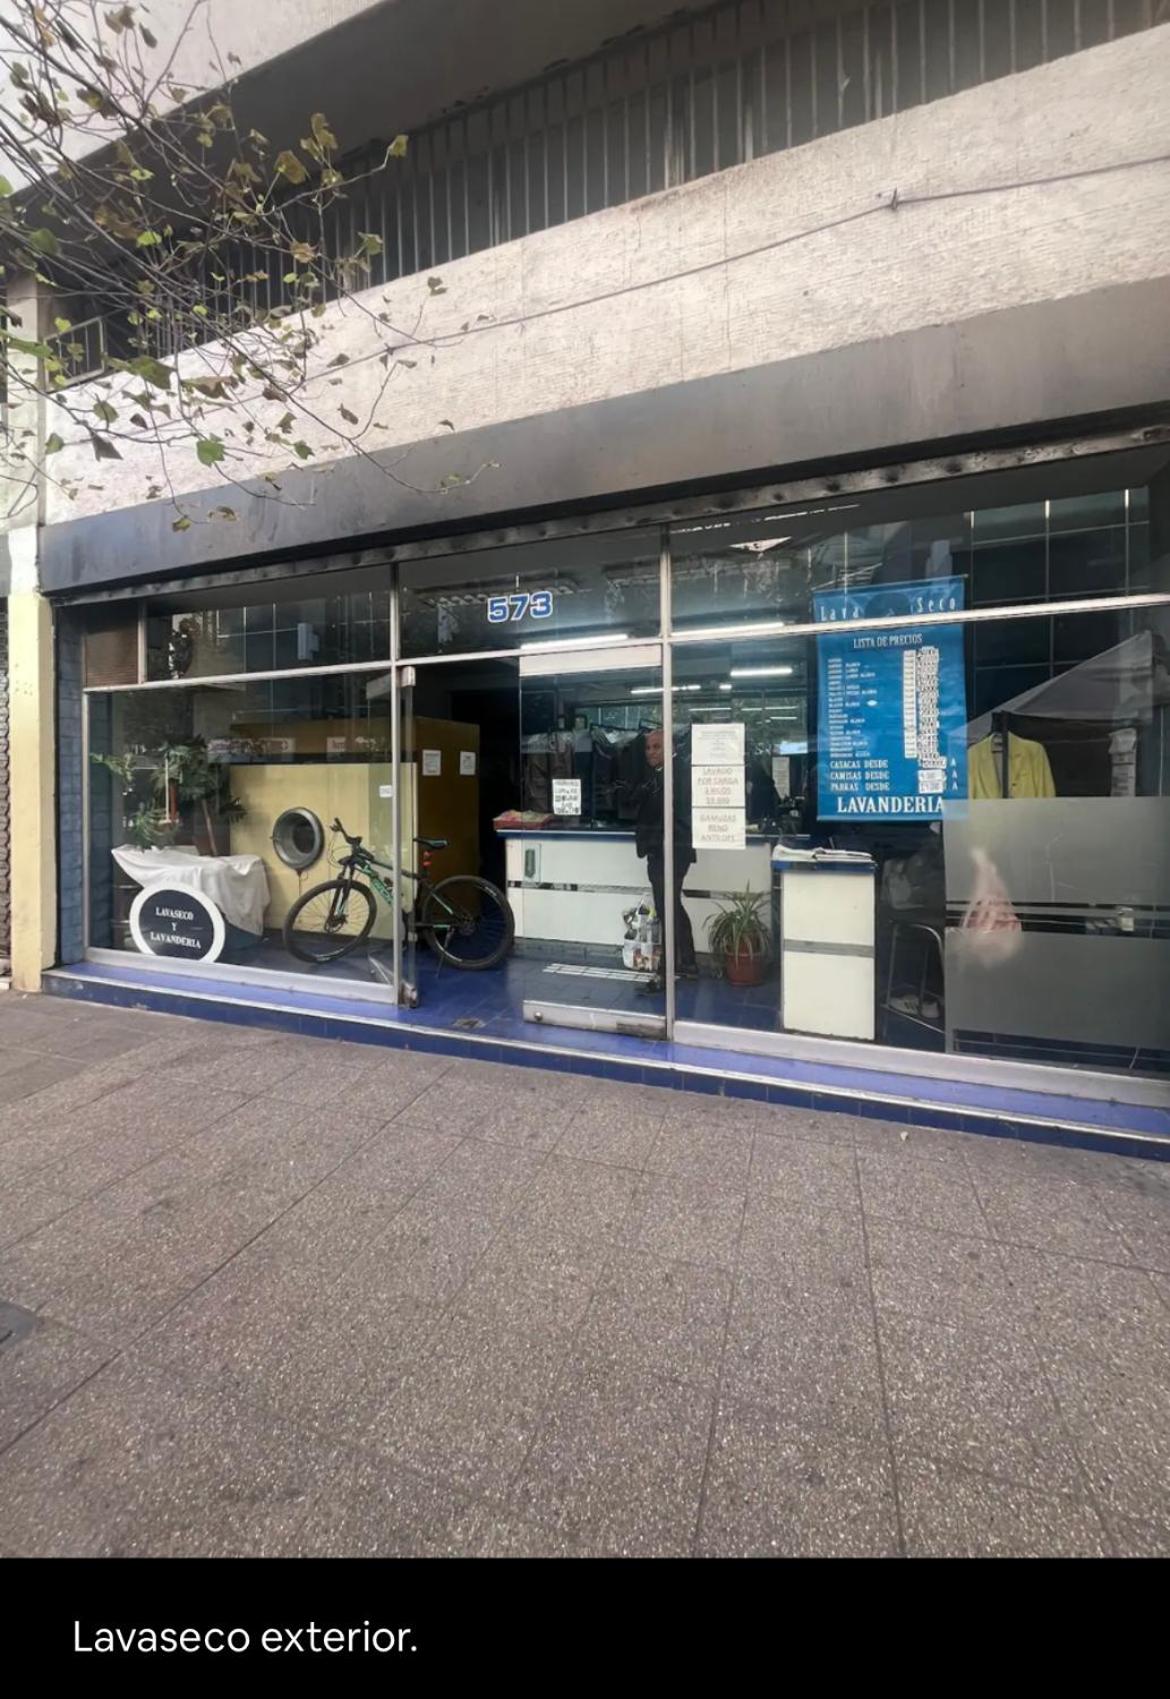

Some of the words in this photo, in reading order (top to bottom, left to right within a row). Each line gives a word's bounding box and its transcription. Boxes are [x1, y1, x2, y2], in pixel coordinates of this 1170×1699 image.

[487, 590, 553, 623] 573
[916, 596, 956, 613] Seco
[853, 637, 875, 649] LISTA
[877, 636, 888, 648] DE
[889, 633, 923, 646] PRECIOS
[830, 760, 861, 769] CASACAS
[864, 759, 889, 768] DESDE
[830, 770, 862, 780] CAMISAS
[864, 770, 890, 780] DESDE
[865, 781, 891, 791] DESDE
[837, 796, 943, 813] LAVANDERIA
[155, 907, 195, 921] LAVASECO
[171, 922, 178, 932] Y
[150, 931, 202, 949] LAVANDERIA
